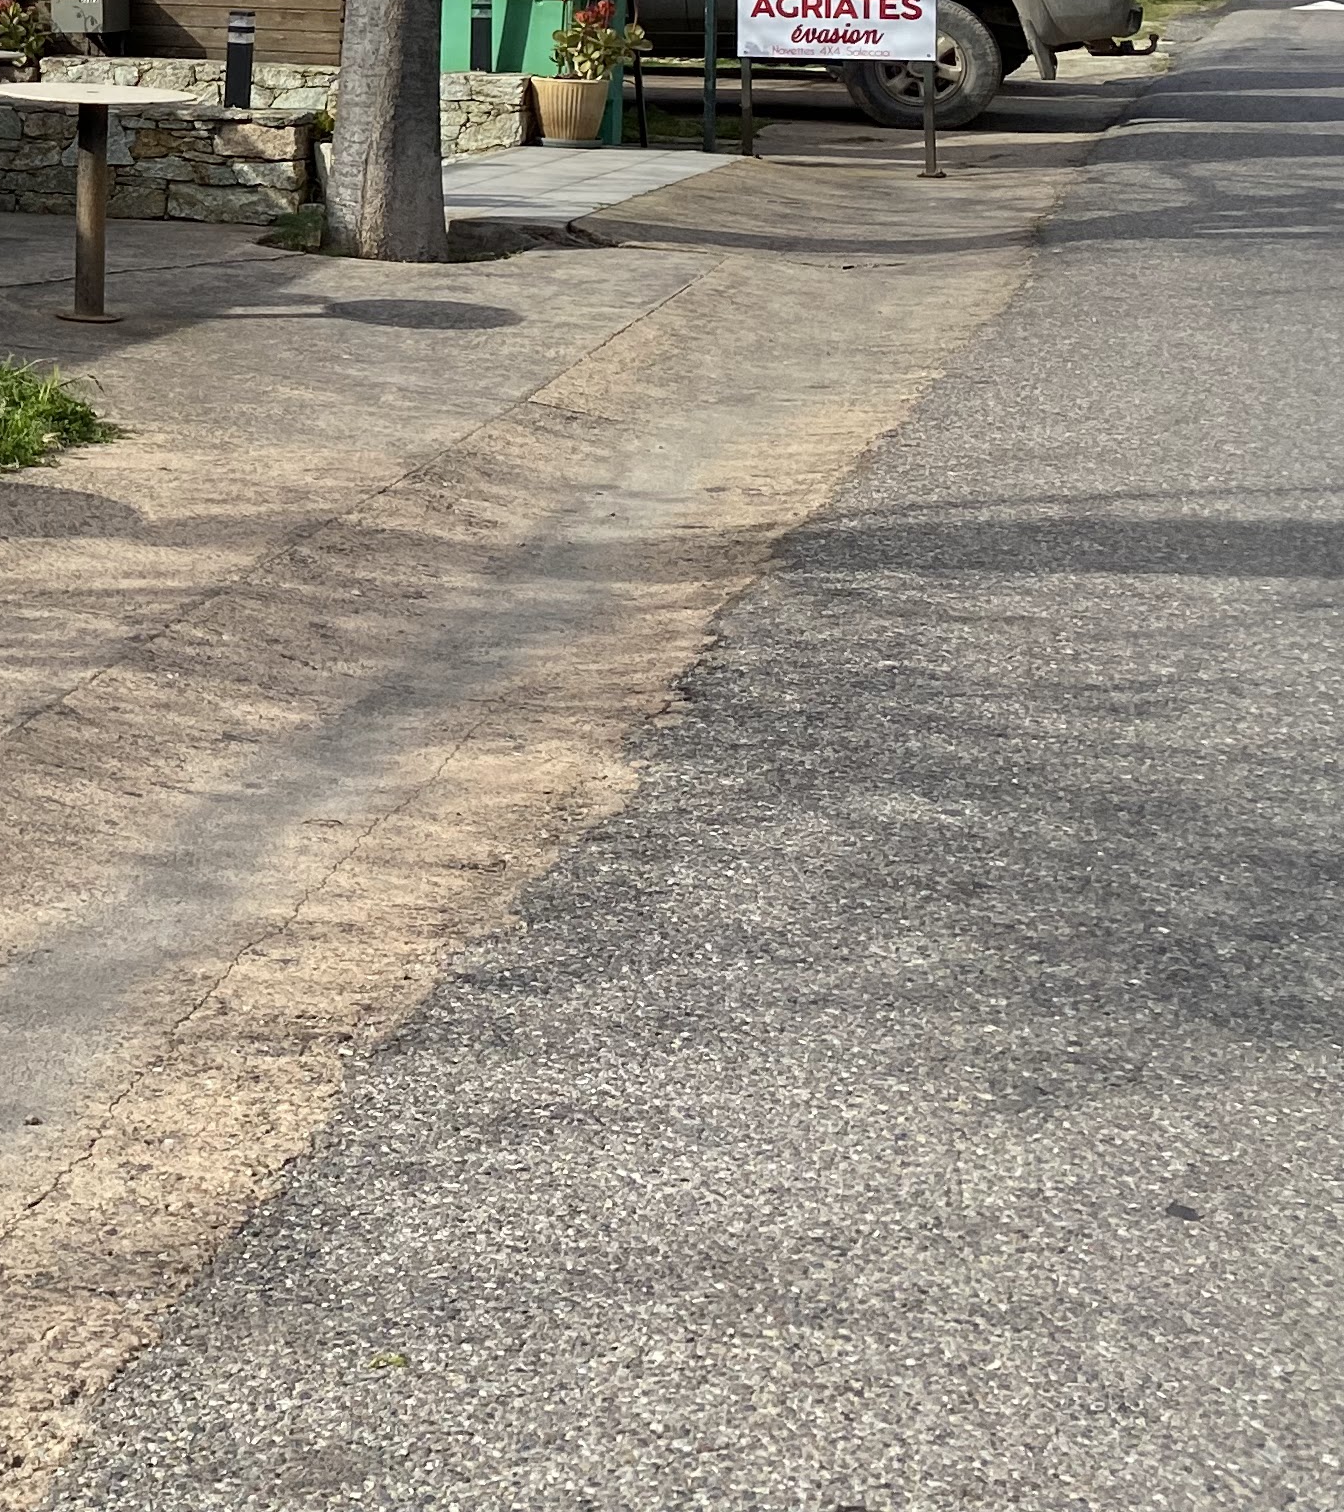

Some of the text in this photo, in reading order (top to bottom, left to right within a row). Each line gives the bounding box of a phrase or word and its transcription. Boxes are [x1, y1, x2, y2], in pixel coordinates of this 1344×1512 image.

[791, 23, 885, 45] évasion
[772, 45, 815, 56] Navettes
[846, 45, 891, 57] Saleccia
